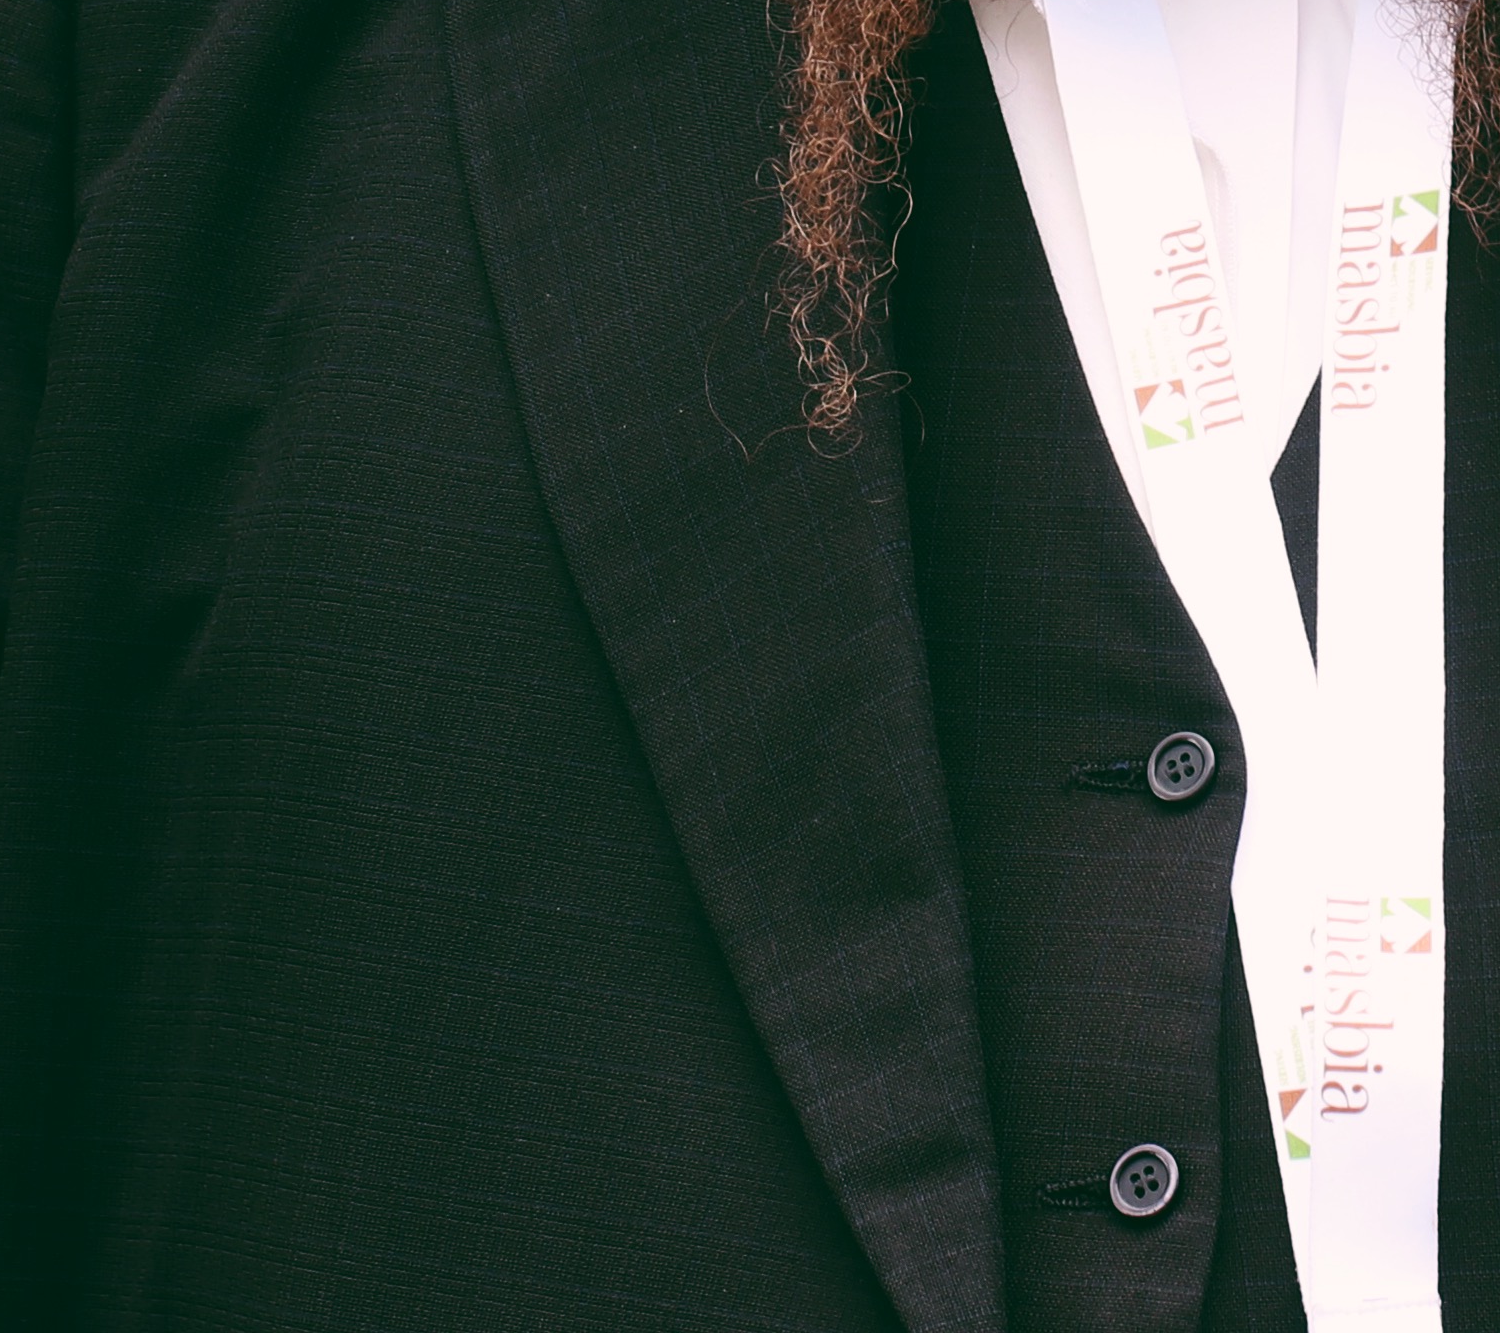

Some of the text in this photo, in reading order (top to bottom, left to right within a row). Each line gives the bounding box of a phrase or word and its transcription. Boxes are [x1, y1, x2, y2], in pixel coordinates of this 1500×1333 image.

[1152, 219, 1244, 434] masbia
[1331, 197, 1400, 414] masbia
[1321, 895, 1394, 1123] masbia
